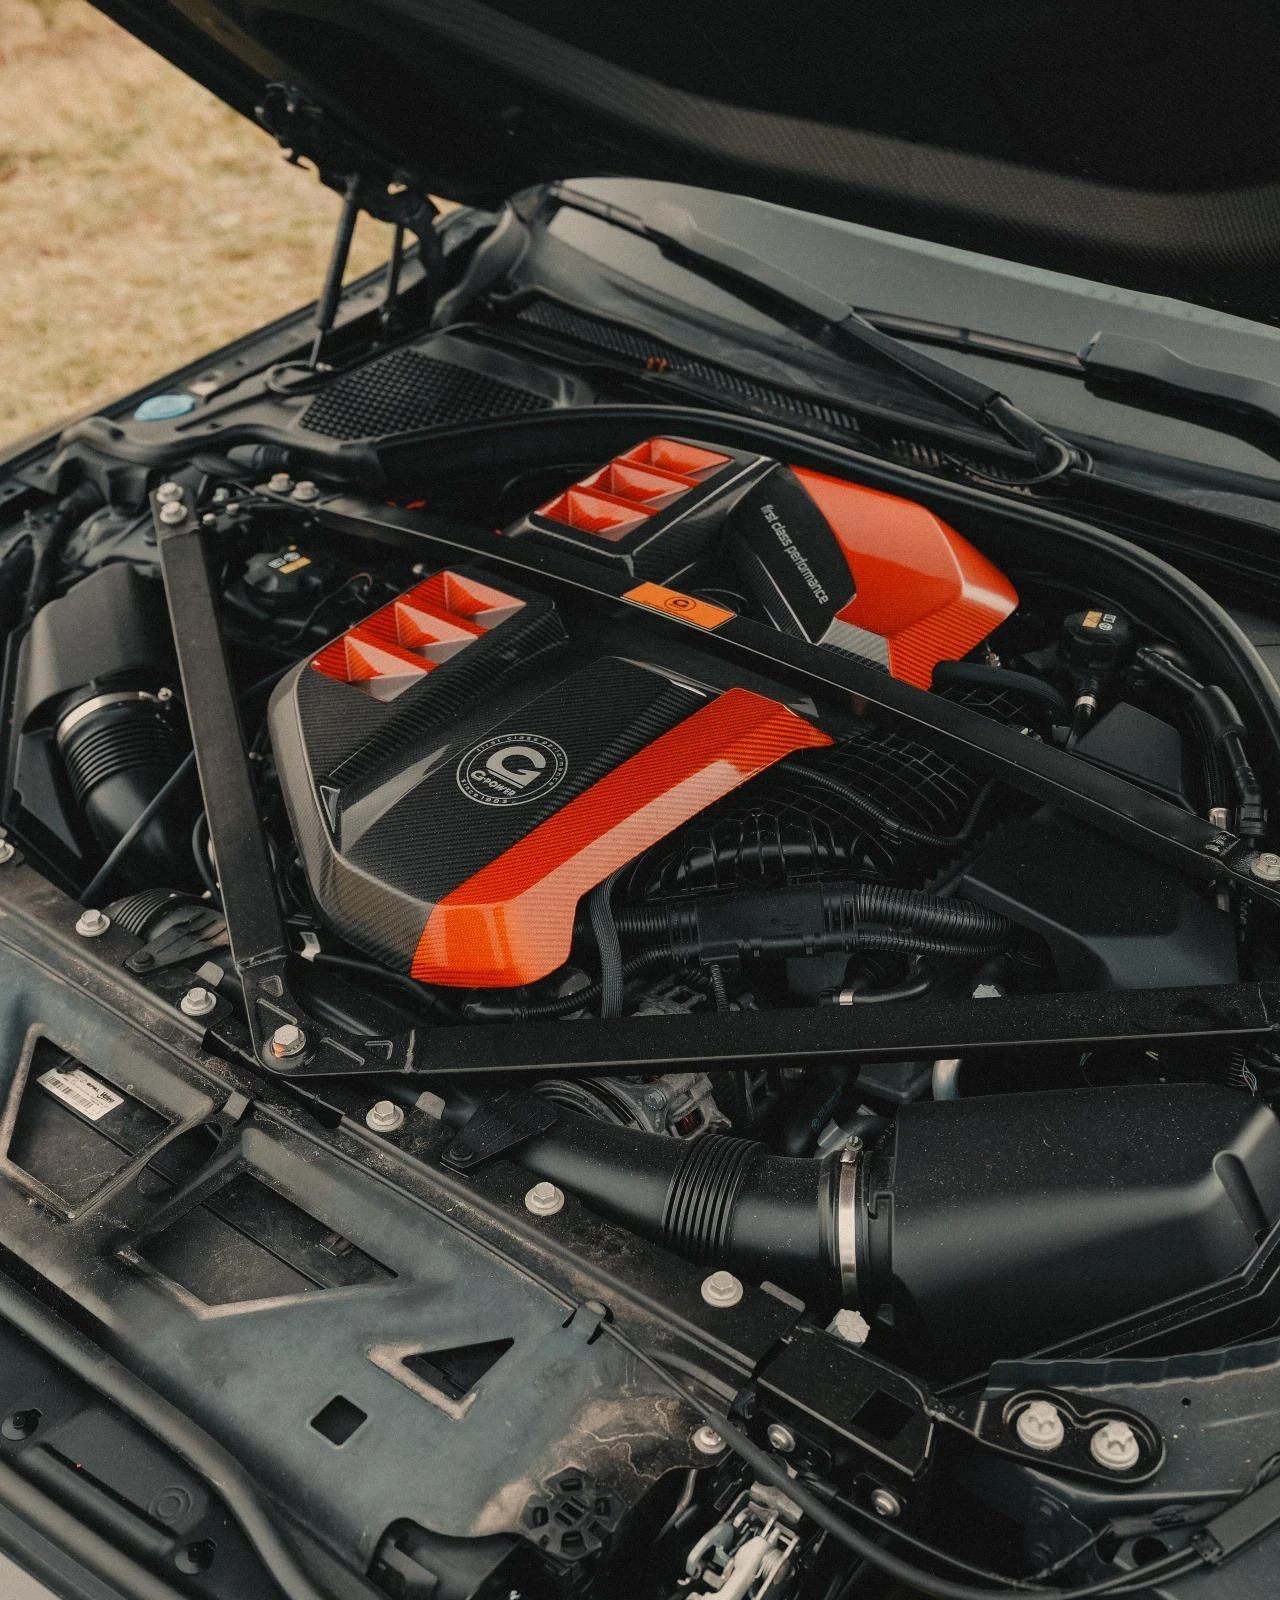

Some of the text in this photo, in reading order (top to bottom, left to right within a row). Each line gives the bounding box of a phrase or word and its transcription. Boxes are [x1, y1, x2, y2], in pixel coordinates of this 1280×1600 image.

[760, 504, 829, 605] first class performance
